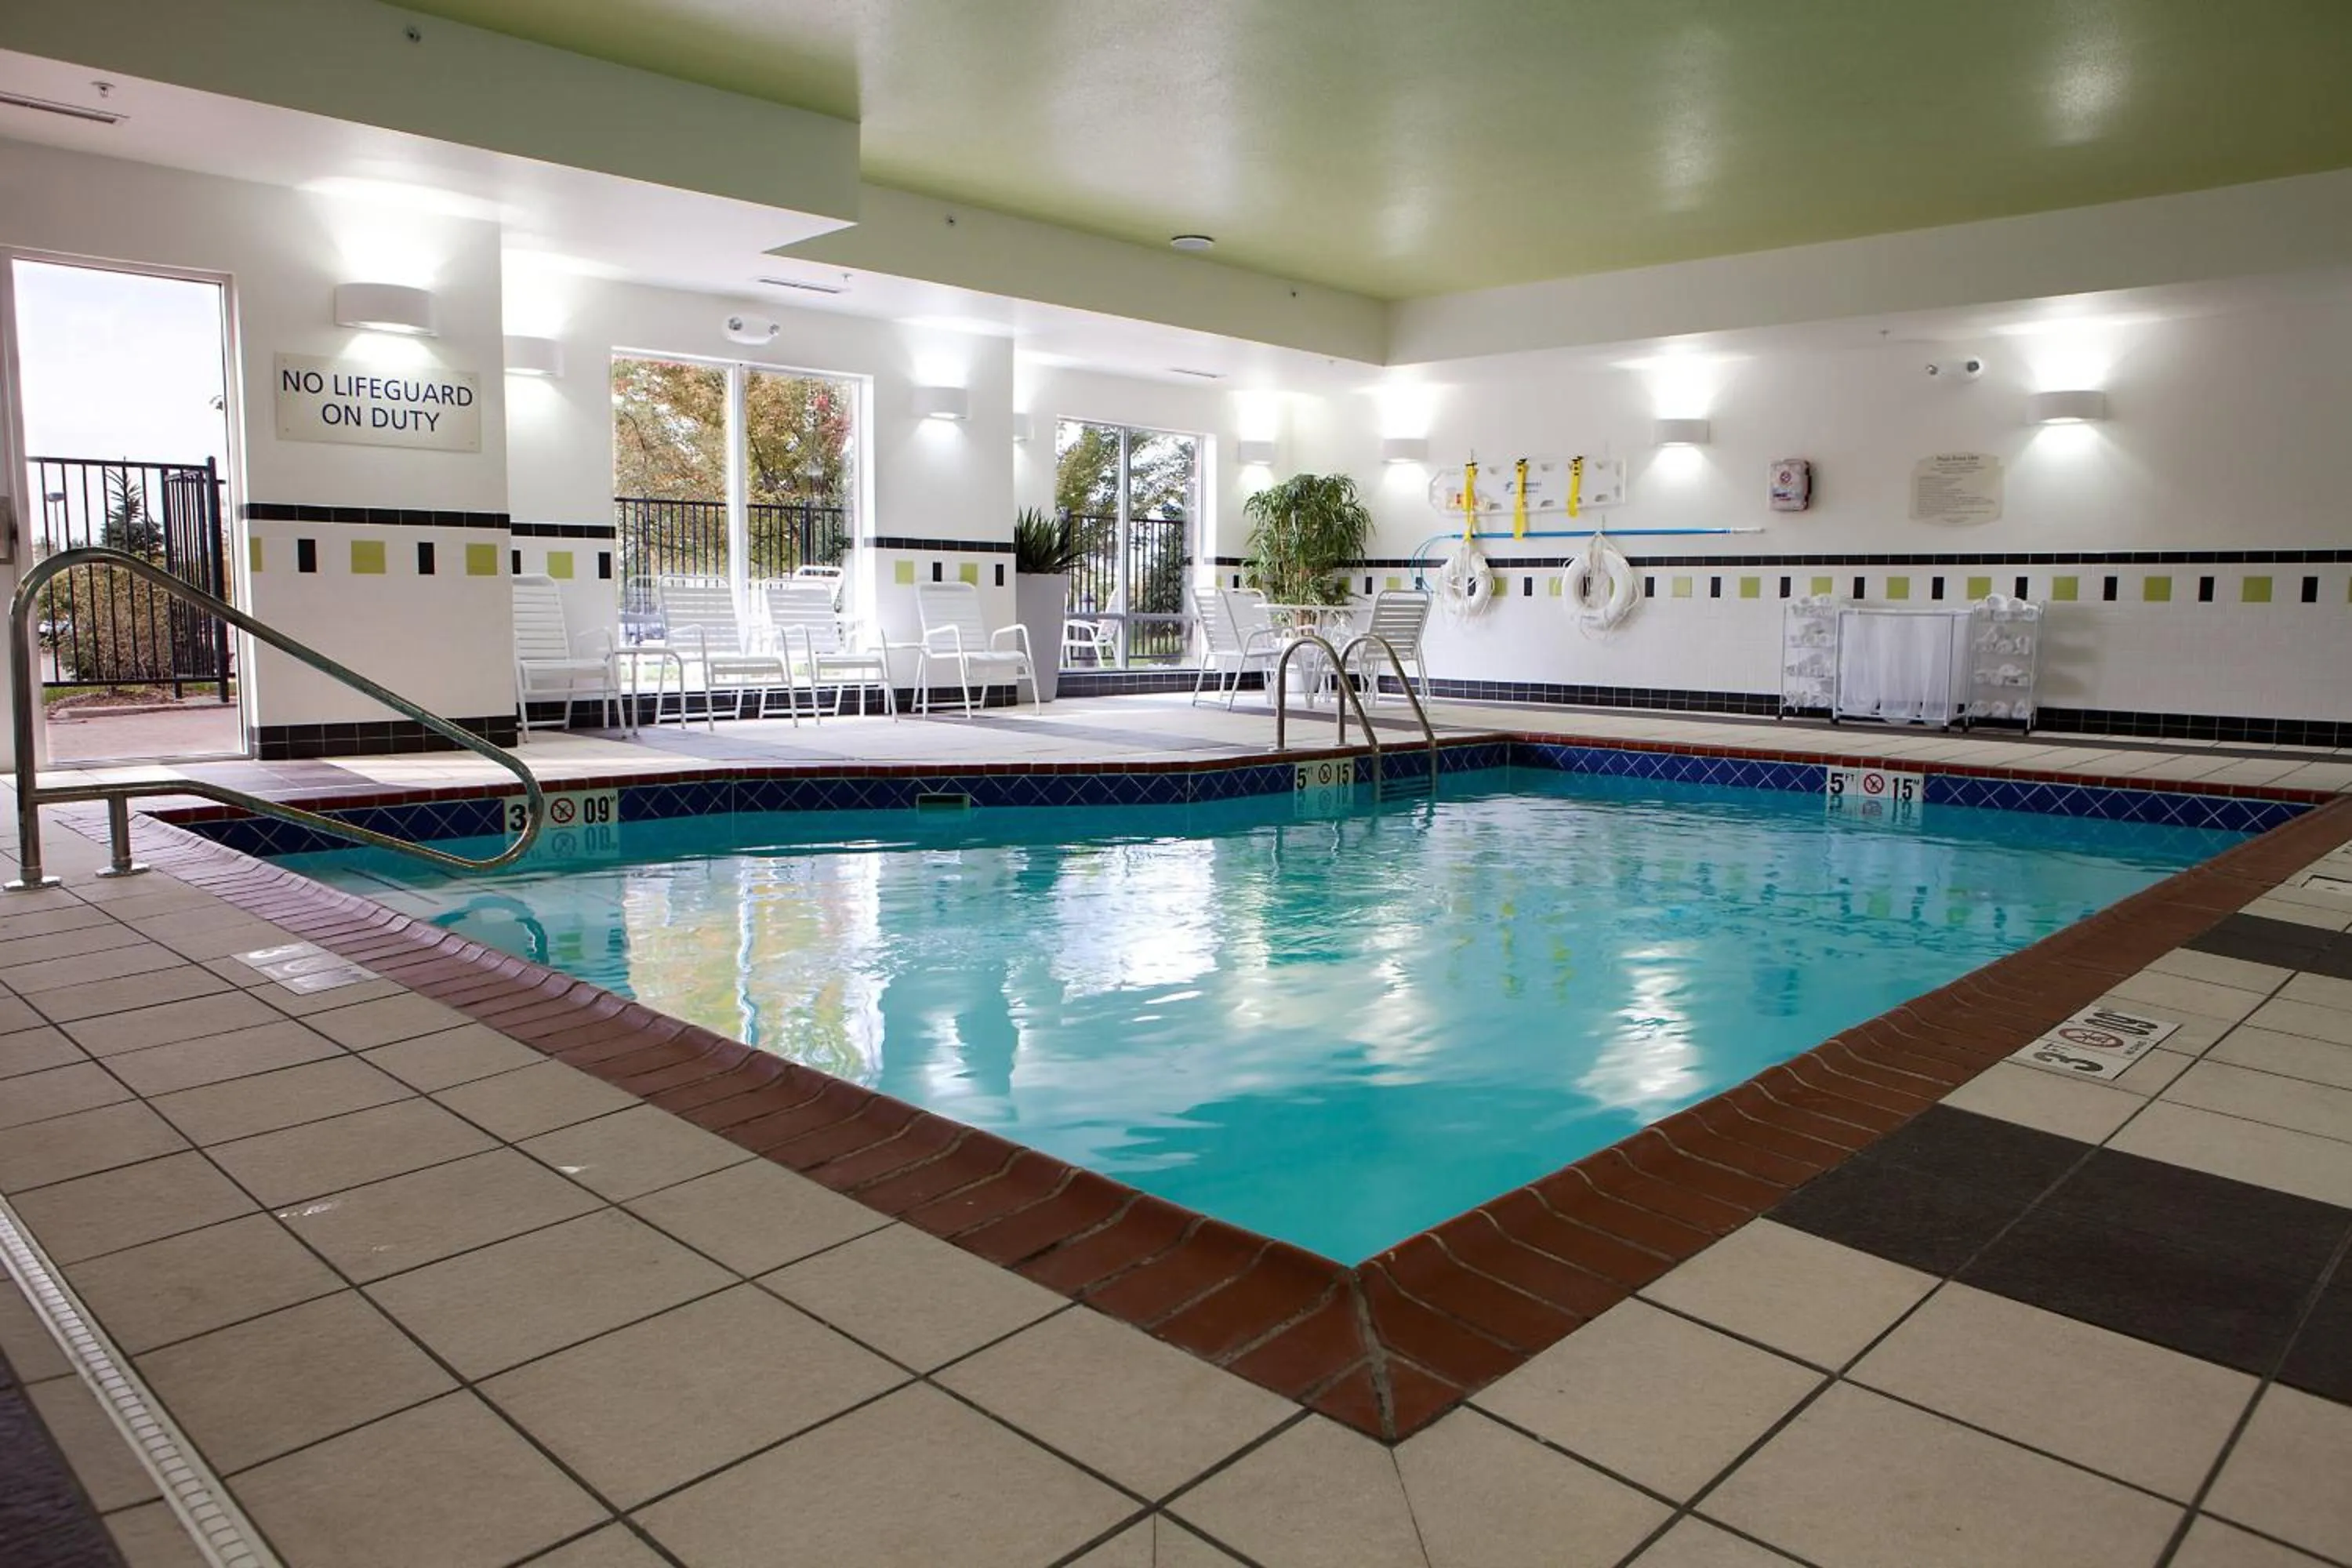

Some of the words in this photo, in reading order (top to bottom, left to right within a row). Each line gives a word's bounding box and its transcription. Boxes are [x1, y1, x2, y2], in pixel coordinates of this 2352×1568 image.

[282, 369, 324, 394] NO
[333, 374, 474, 407] LIFEGUARD
[321, 403, 361, 427] ON
[372, 407, 440, 432] DUTY
